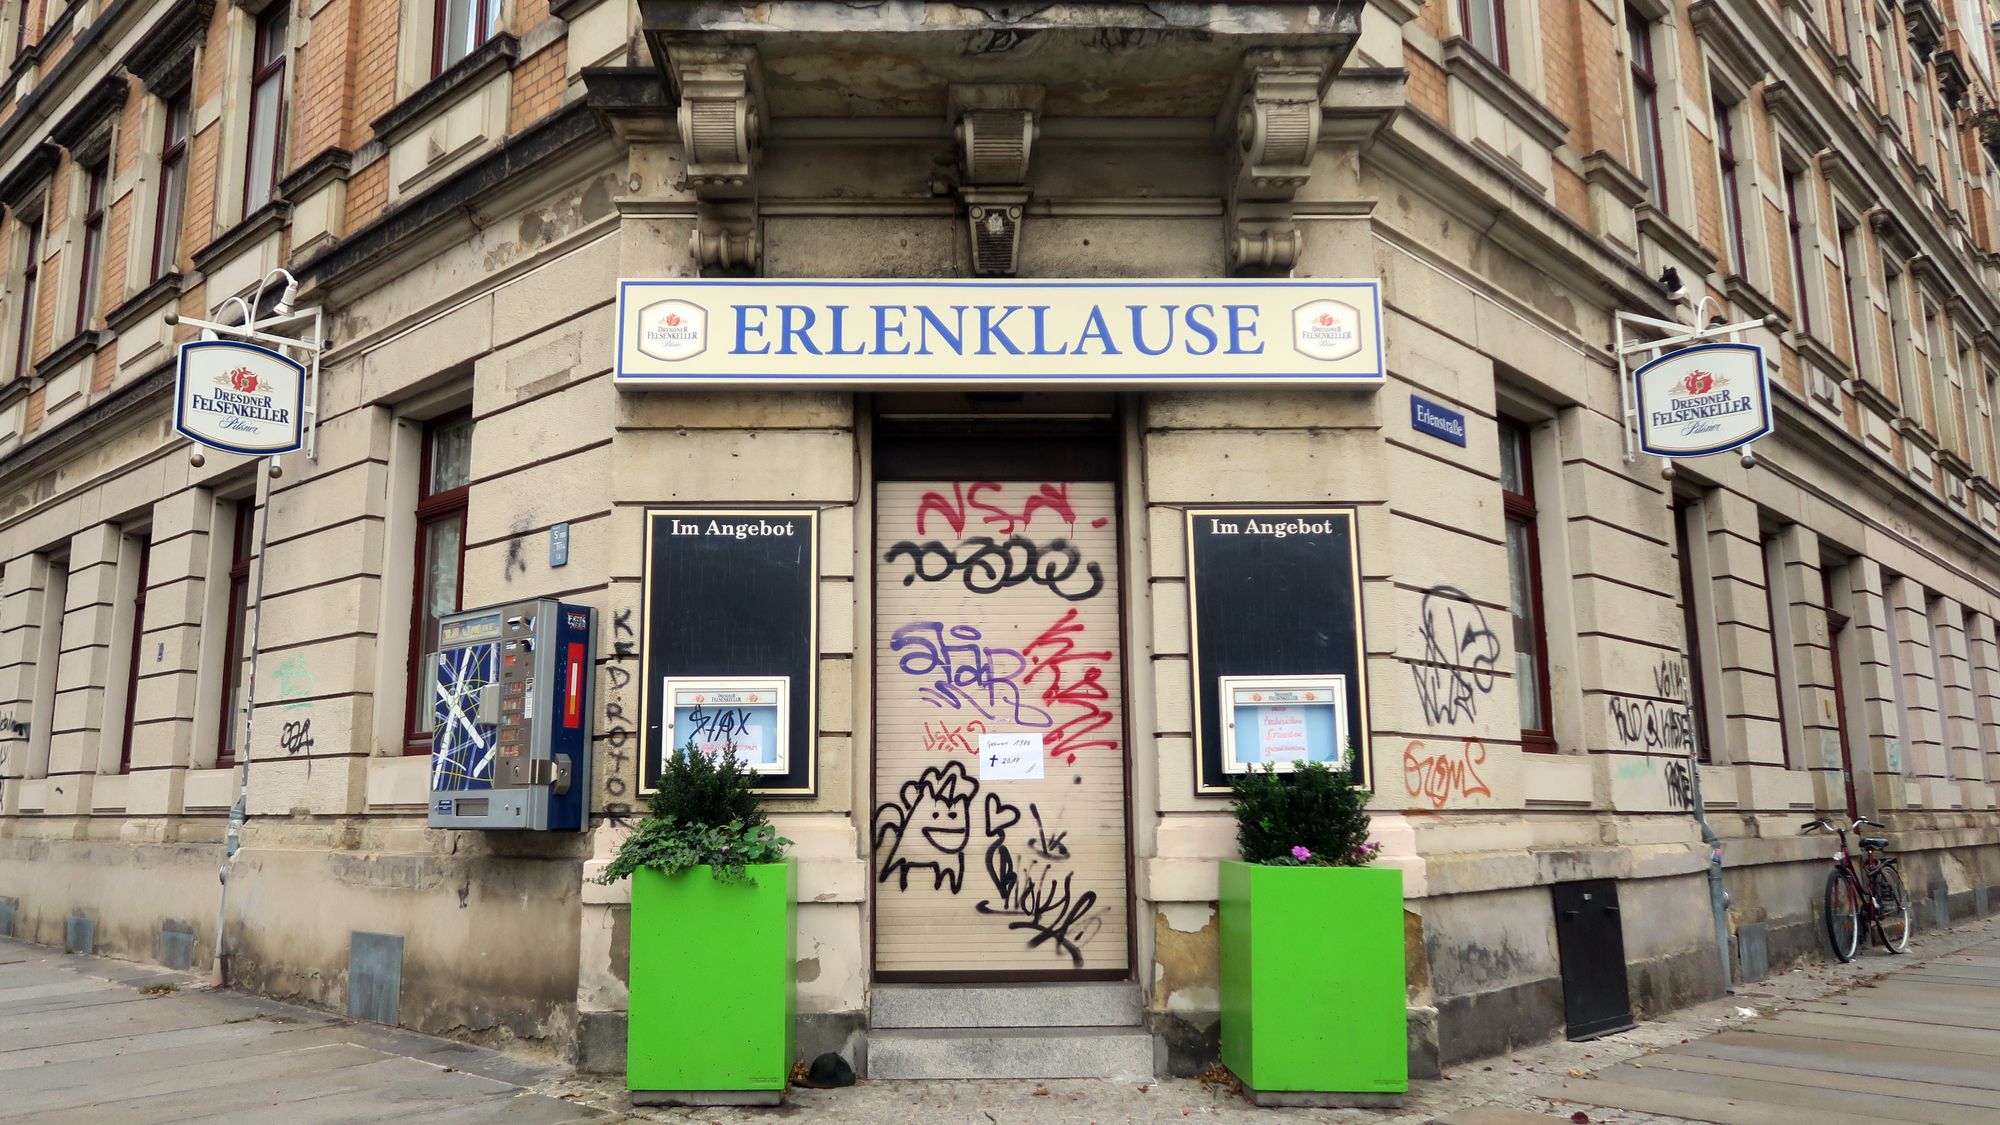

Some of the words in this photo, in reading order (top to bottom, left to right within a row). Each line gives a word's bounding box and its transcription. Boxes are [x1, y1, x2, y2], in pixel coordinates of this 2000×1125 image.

[647, 331, 698, 340] FELSENKELLER
[728, 304, 1266, 356] ERLENKLAUSE
[214, 387, 272, 408] DRESDNER
[1671, 389, 1731, 411] DRESDNER
[192, 394, 289, 424] FELSENKELLER
[1652, 396, 1753, 426] FELSENKELLER
[219, 416, 261, 434] Pilsner
[1416, 404, 1463, 436] Erlenstraße
[671, 520, 700, 535] Im
[705, 520, 794, 539] Angebot
[1210, 519, 1239, 534] Im
[1244, 519, 1333, 538] Angebot
